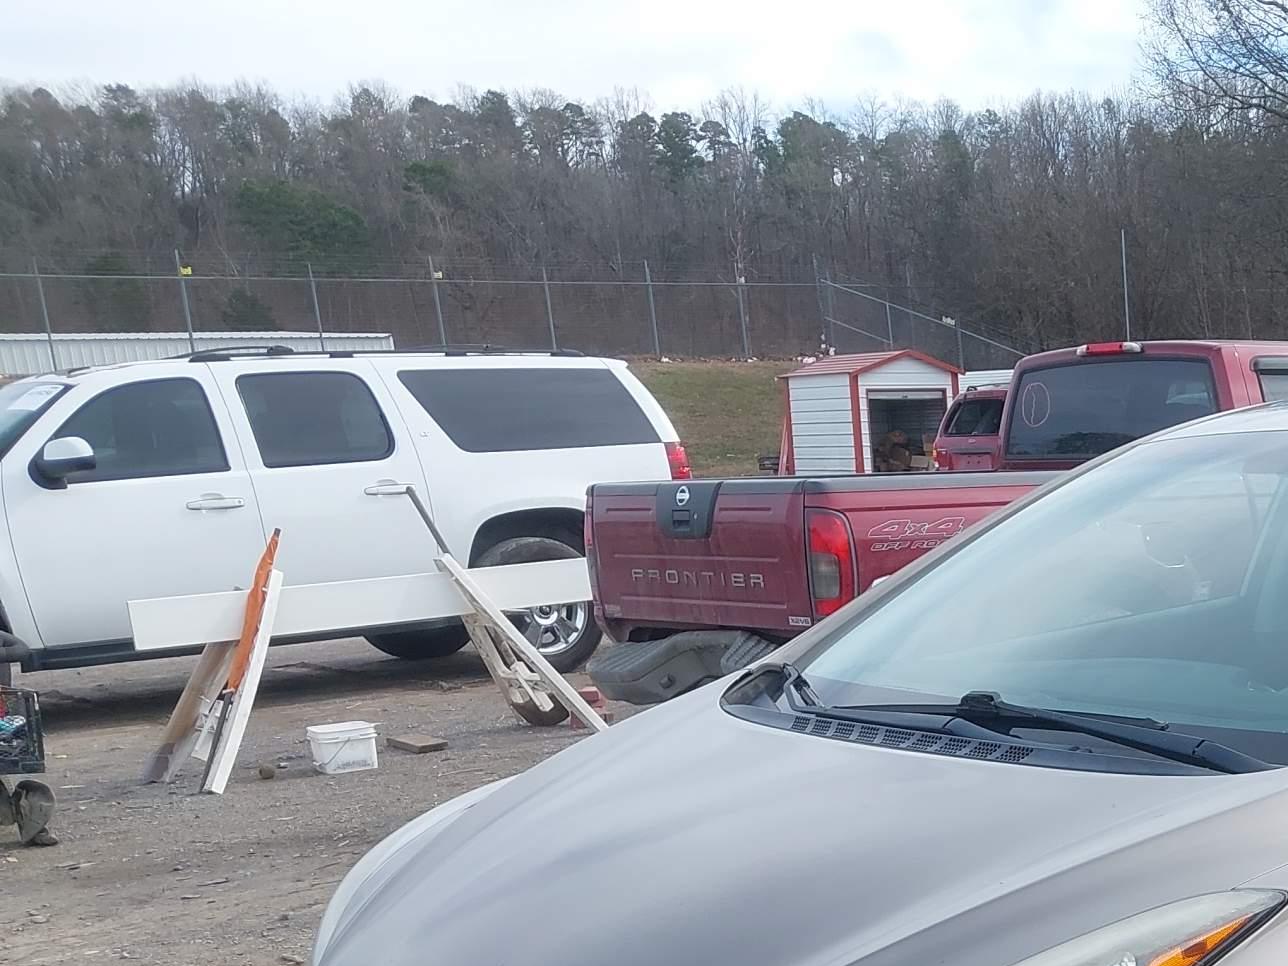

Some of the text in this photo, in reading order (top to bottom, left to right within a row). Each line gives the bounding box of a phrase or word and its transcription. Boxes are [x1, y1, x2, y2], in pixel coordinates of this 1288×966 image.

[868, 516, 966, 540] 4x4
[871, 541, 911, 551] OFF
[631, 568, 765, 588] FRONTIER
